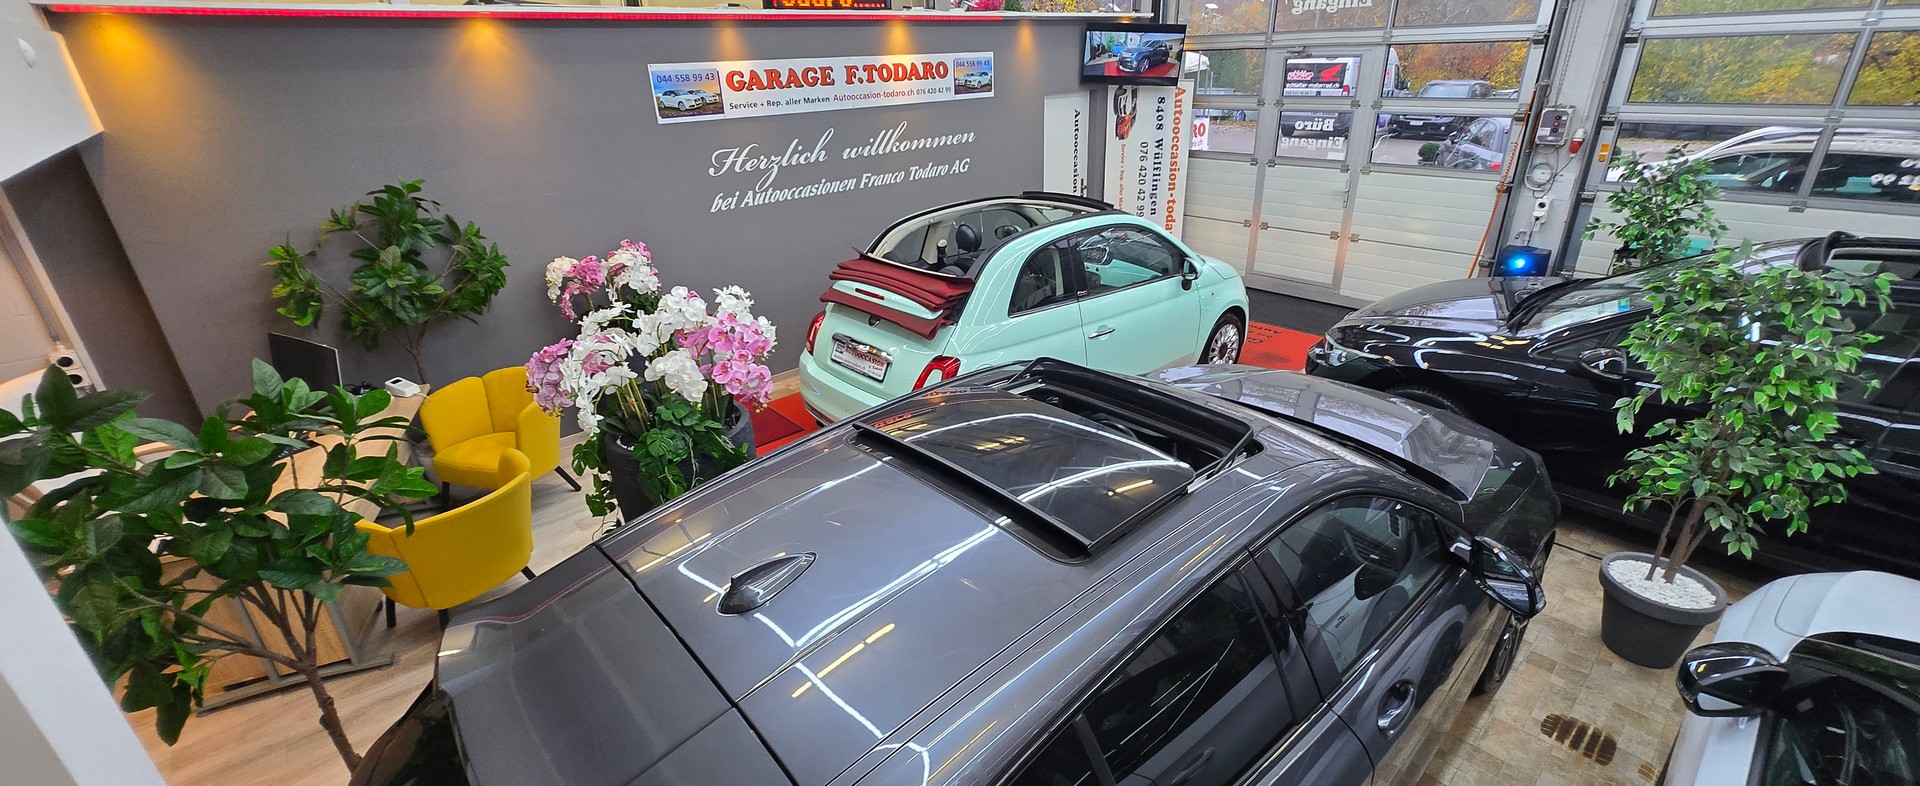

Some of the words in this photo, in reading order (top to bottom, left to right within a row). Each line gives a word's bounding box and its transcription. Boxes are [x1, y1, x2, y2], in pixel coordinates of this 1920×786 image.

[725, 65, 836, 92] GARAGE
[844, 60, 949, 85] F.TODARO
[966, 60, 976, 68] 558
[656, 73, 673, 84] 044
[674, 73, 691, 83] 558
[692, 72, 703, 82] 99
[705, 72, 715, 81] 43
[729, 101, 758, 110] Service
[766, 99, 784, 109] Rep.
[785, 97, 802, 106] aller
[803, 95, 830, 104] Marken
[833, 89, 915, 102] Autooccasion-todaro.ch
[1155, 96, 1166, 131] 8408
[708, 127, 835, 192] Herzlich
[841, 121, 976, 160] willkommen
[1072, 109, 1081, 193] Autooccasion
[1139, 141, 1149, 162] 076
[1165, 86, 1187, 233] Autooccasion-toda
[710, 191, 740, 213] bei
[740, 177, 857, 208] Autooccasionen
[859, 171, 905, 189] Franco
[909, 162, 949, 181] Todaro
[950, 158, 970, 175] AG
[1138, 165, 1147, 185] 420
[1150, 138, 1164, 215] Wülflingen
[1137, 188, 1146, 201] 42
[1136, 204, 1145, 217] 99
